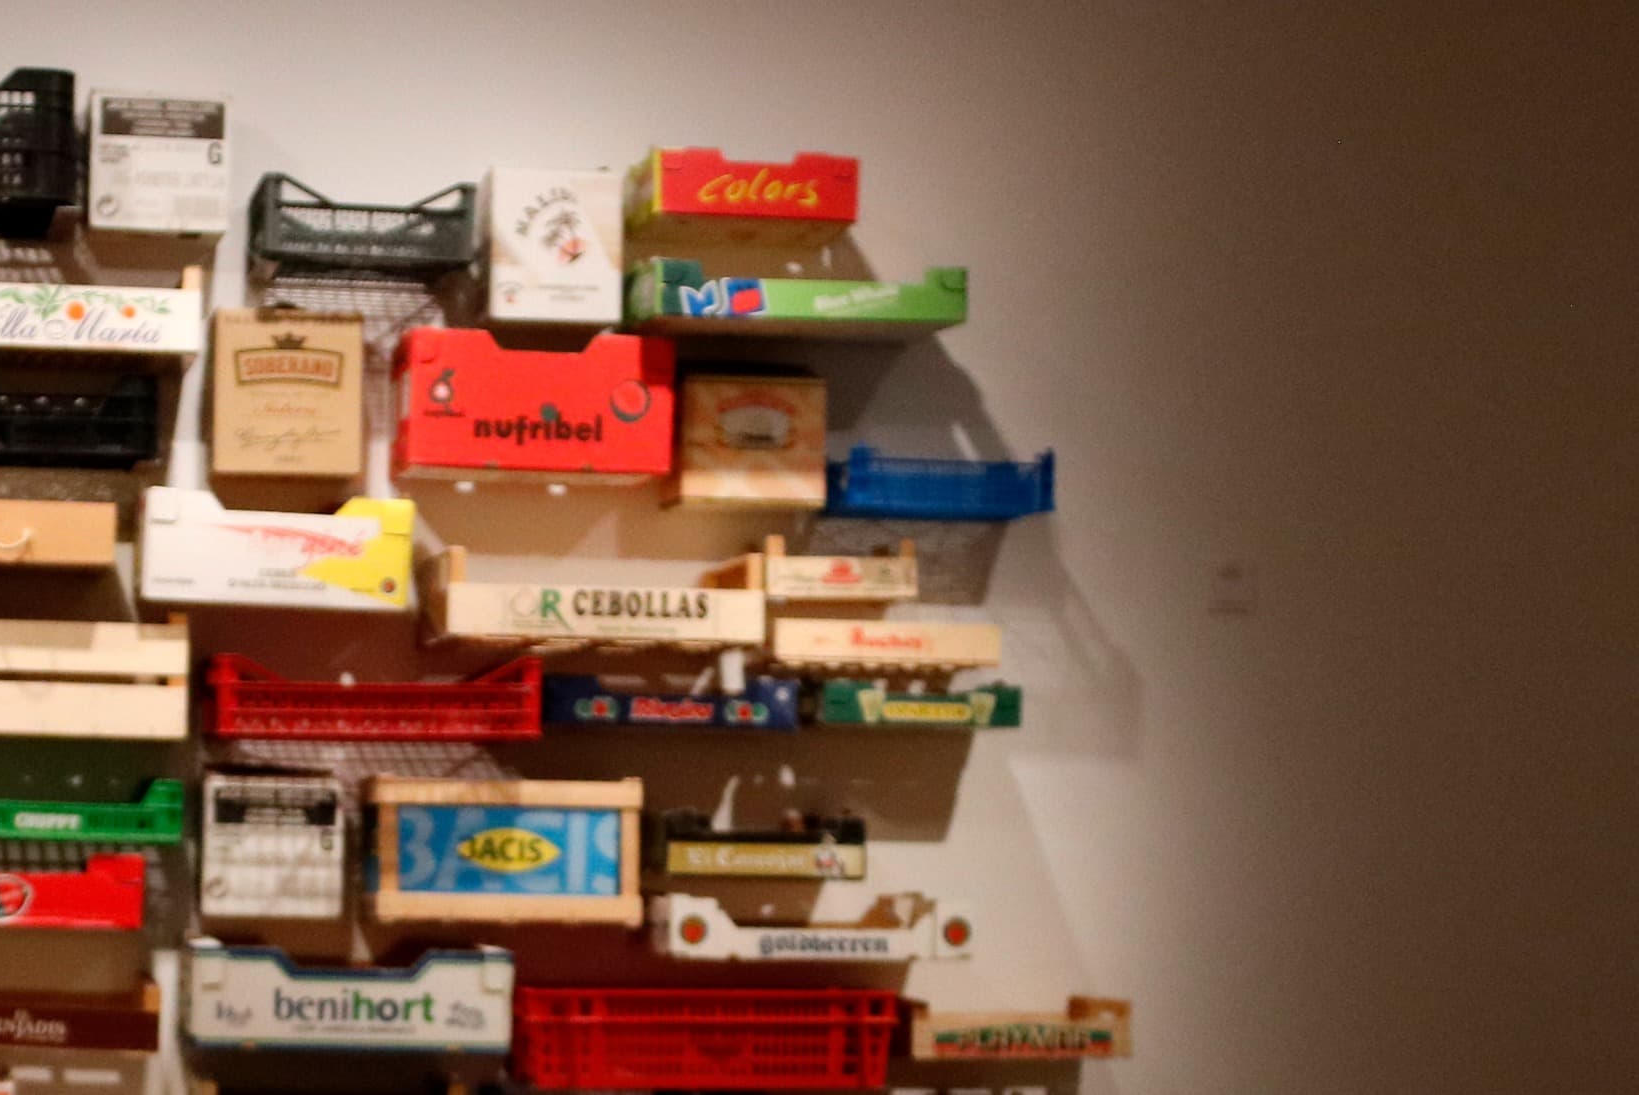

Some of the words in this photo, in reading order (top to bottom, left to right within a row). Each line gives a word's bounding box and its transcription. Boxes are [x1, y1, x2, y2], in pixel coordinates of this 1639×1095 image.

[207, 140, 223, 165] G
[243, 355, 334, 378] SOBERANO
[474, 406, 604, 444] nufribel
[572, 589, 709, 619] CEBOLLAS
[758, 934, 889, 956] goldbeeren
[273, 986, 436, 1024] benihort
